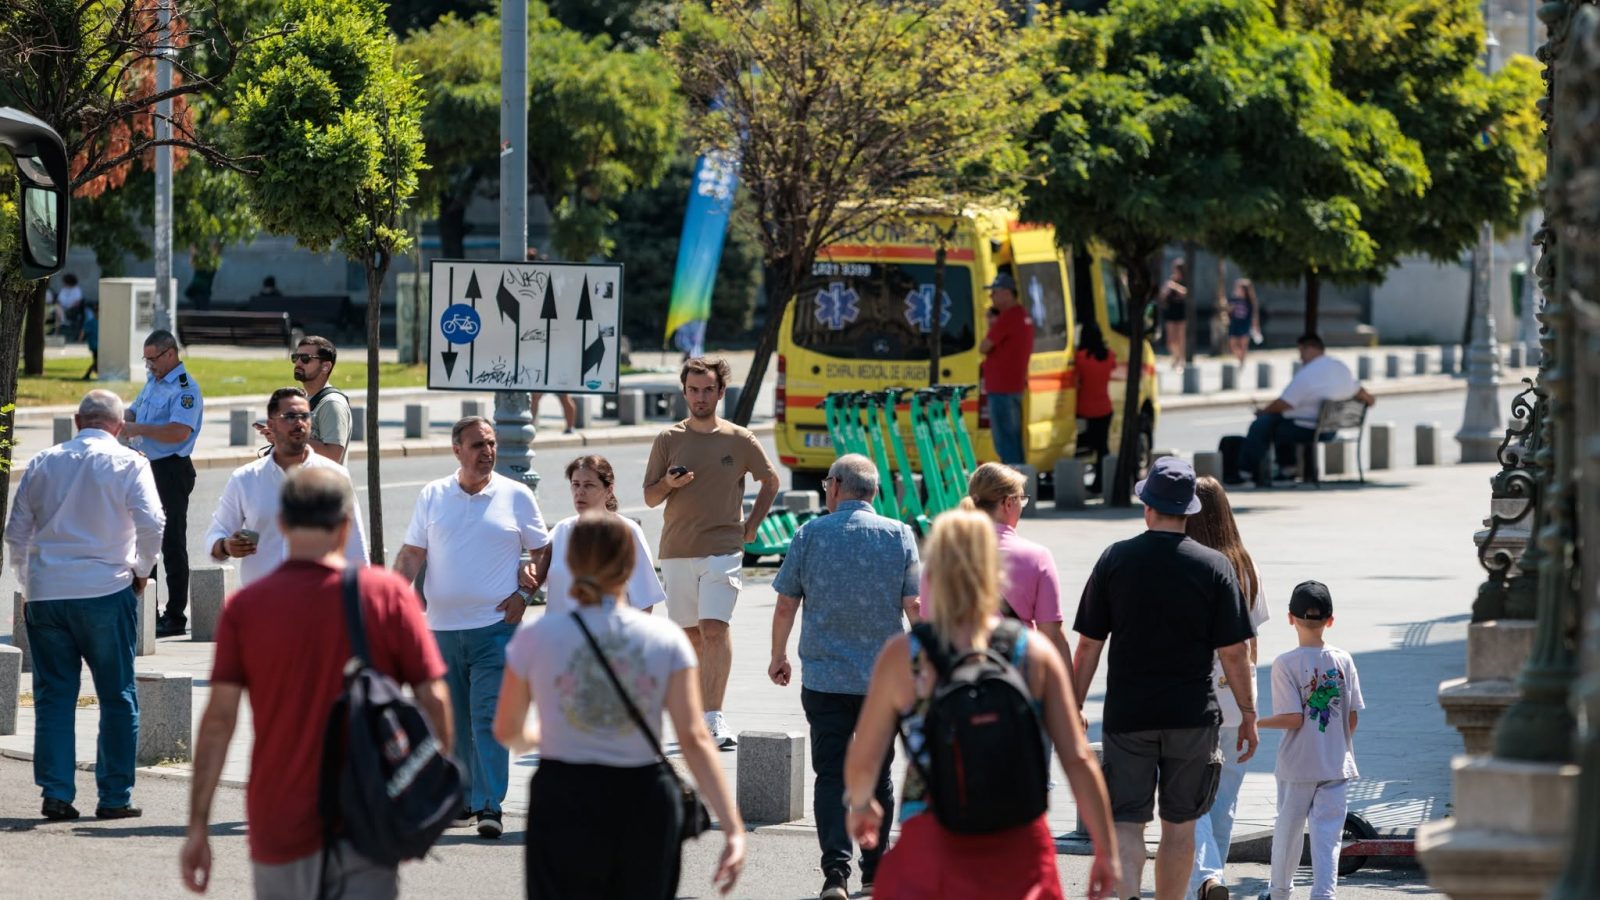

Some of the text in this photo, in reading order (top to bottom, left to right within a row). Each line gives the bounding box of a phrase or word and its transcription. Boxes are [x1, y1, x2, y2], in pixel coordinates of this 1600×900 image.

[857, 364, 889, 379] MEDICAL
[890, 365, 901, 379] DE
[902, 366, 929, 380] URGEN
